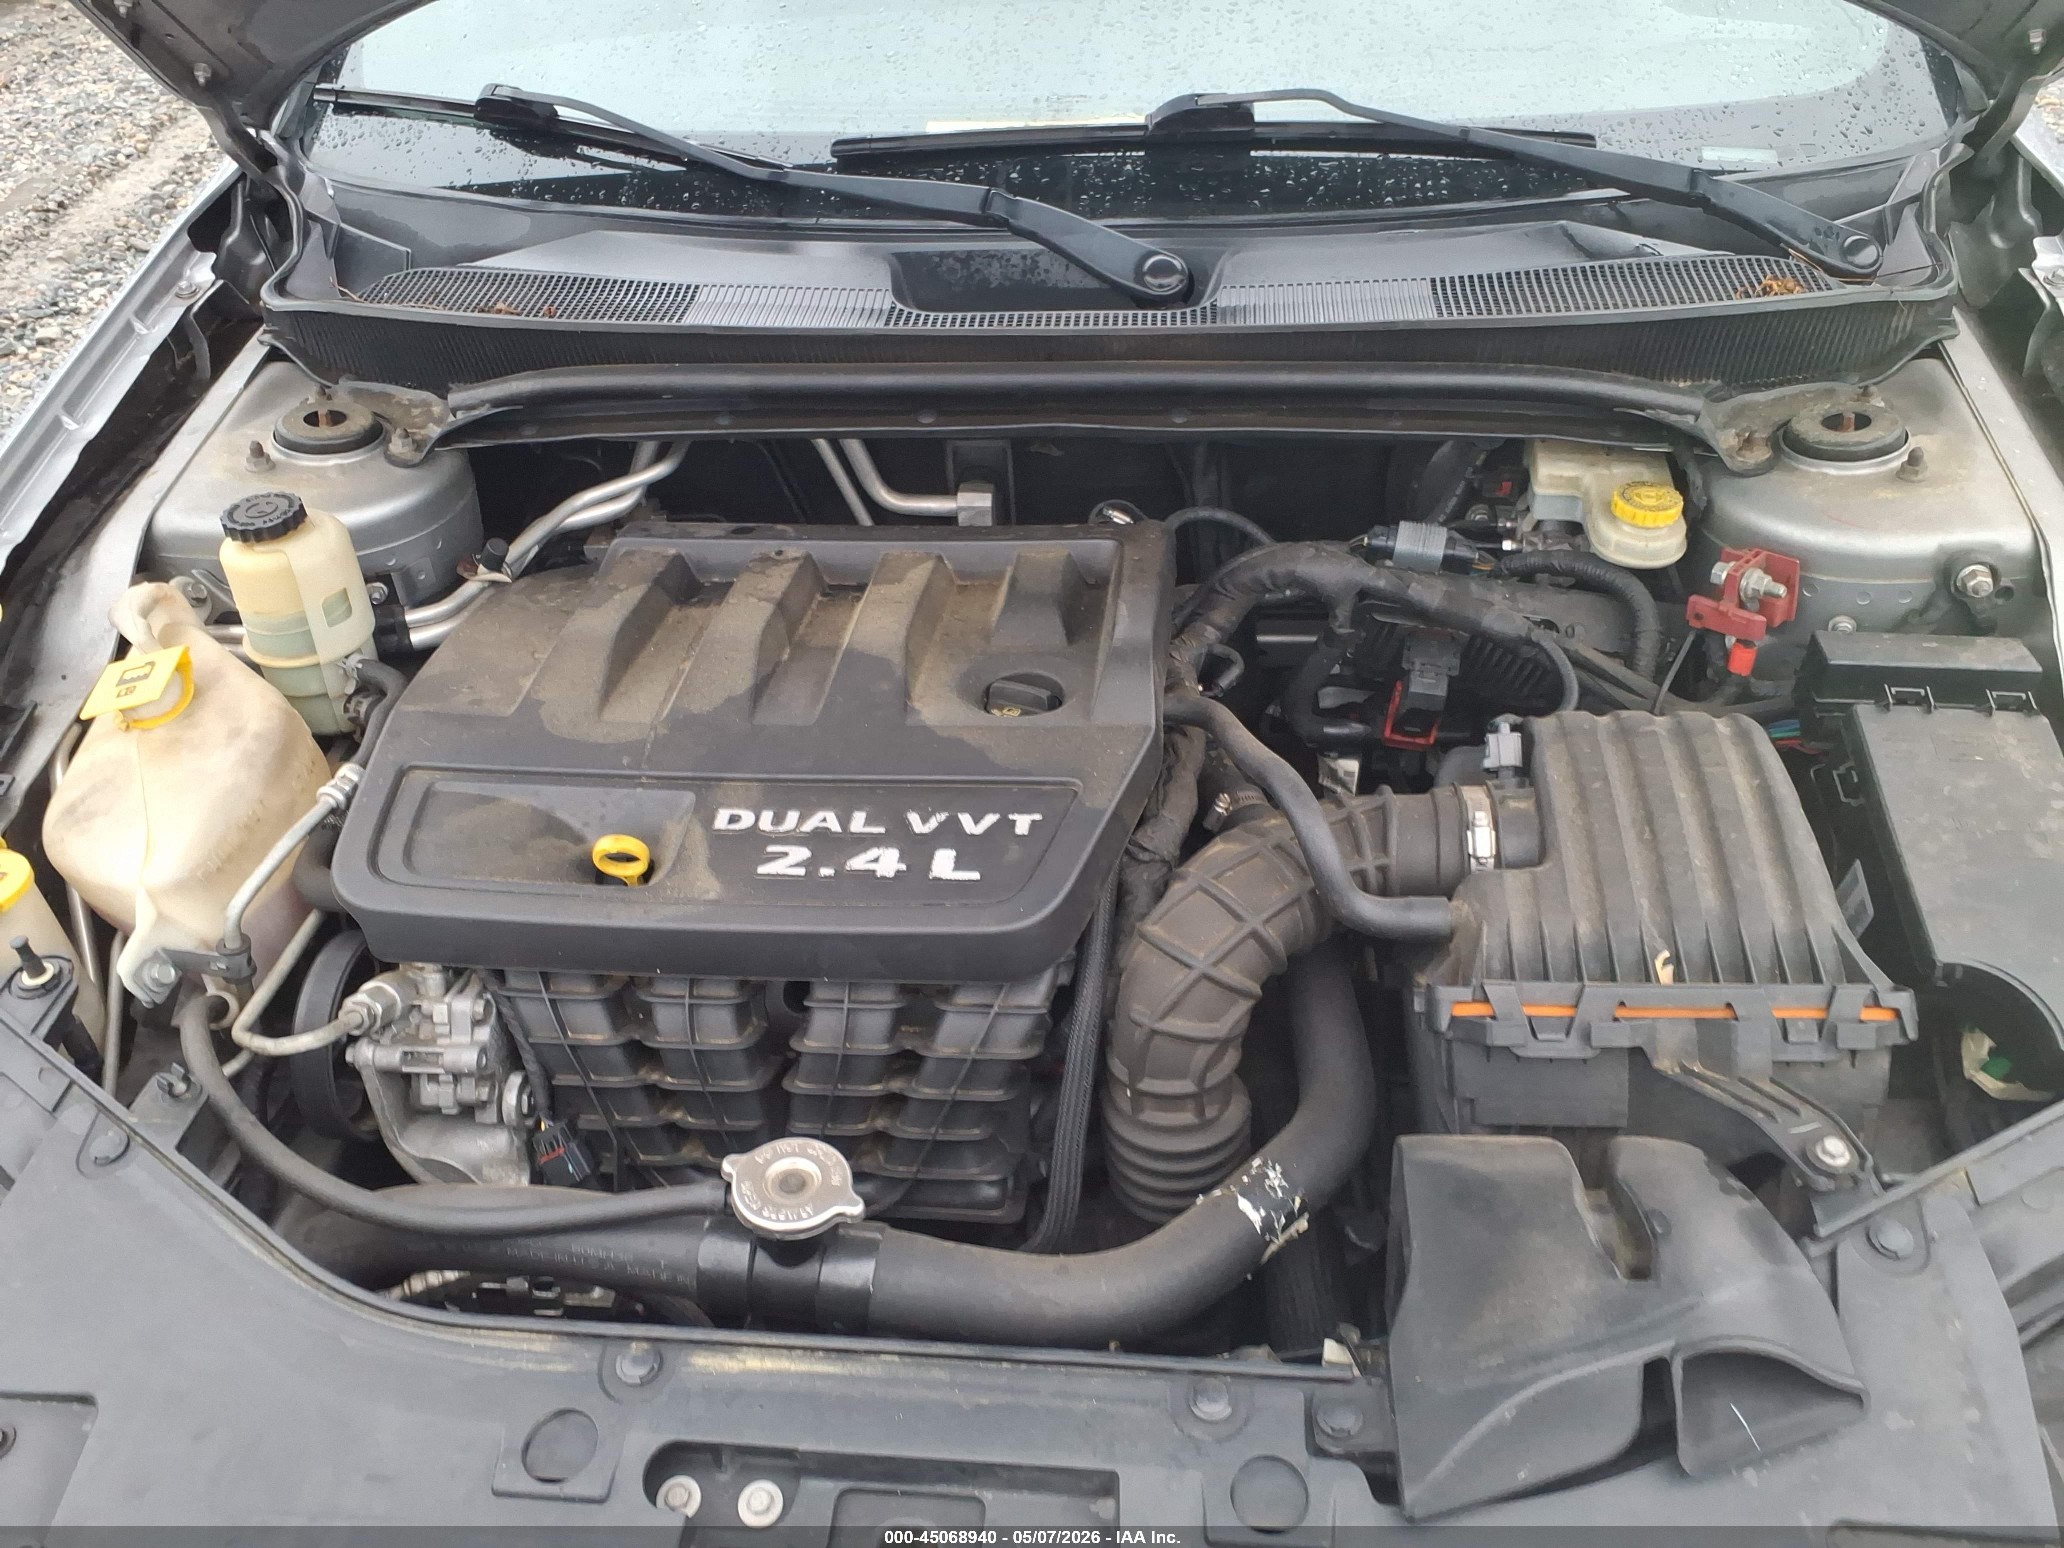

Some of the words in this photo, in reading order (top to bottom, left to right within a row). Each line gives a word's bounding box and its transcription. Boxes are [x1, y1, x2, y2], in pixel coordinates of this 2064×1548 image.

[714, 808, 886, 833] DUAL
[907, 812, 1042, 834] VVT
[757, 845, 906, 877] 2.4
[929, 849, 980, 880] L
